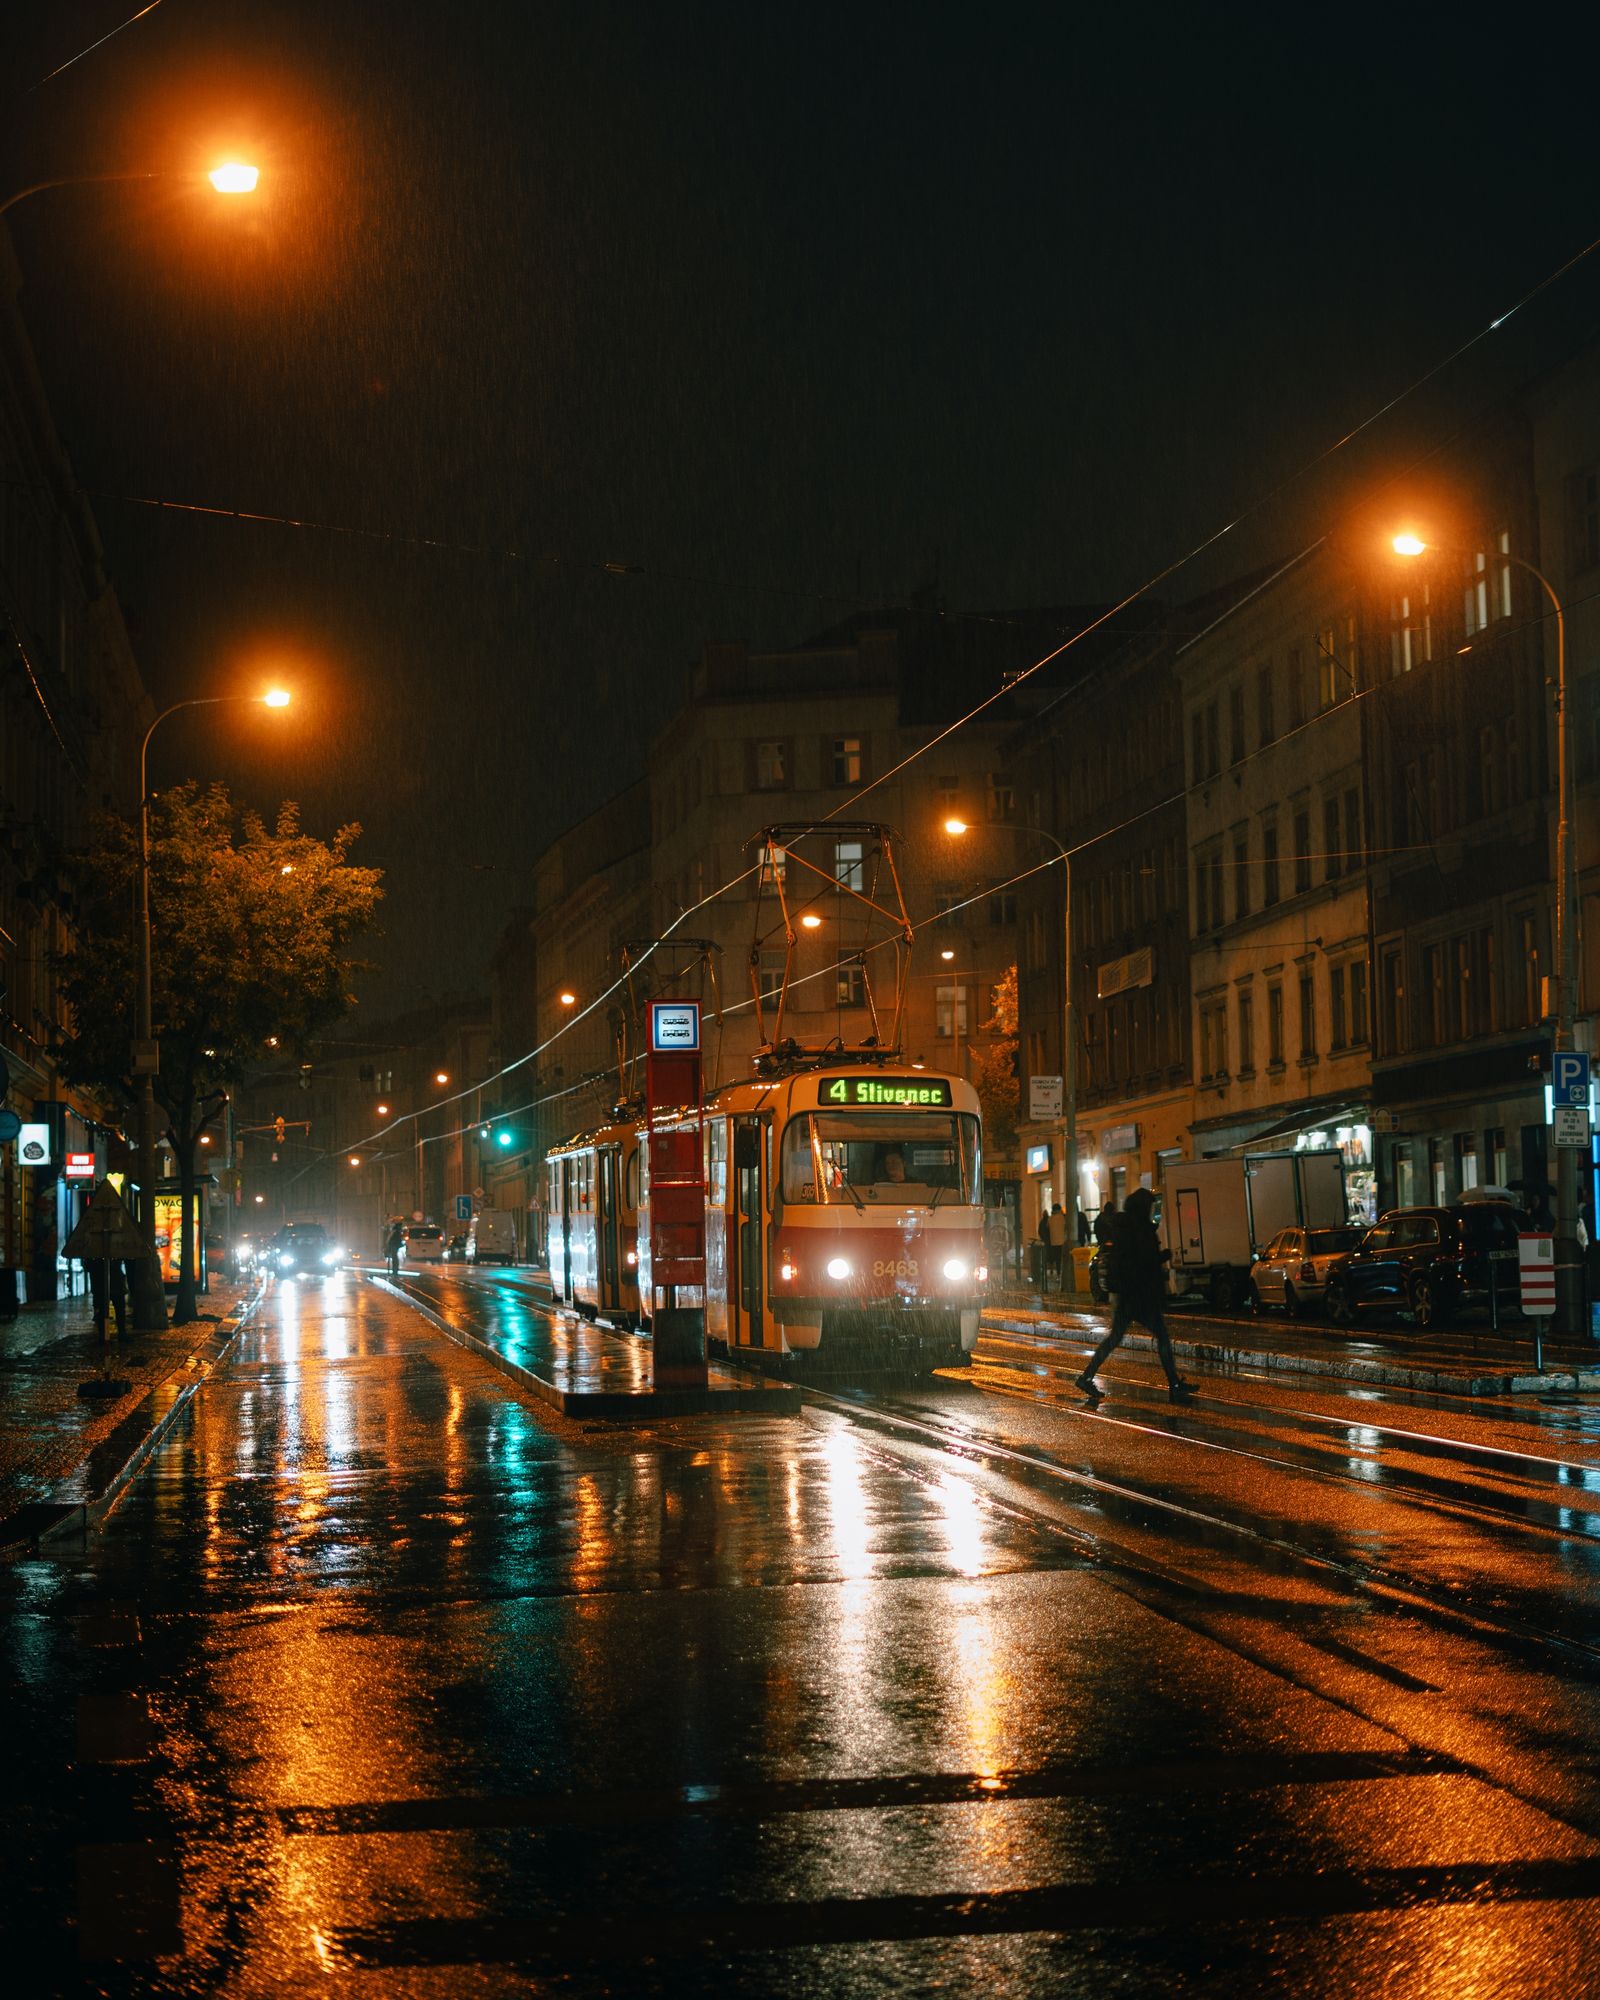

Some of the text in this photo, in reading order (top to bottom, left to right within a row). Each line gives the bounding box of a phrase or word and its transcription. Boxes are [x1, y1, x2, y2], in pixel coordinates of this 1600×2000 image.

[1561, 1059, 1581, 1089] P
[830, 1080, 942, 1104] 4 Slivenec
[873, 1260, 918, 1277] 8468
